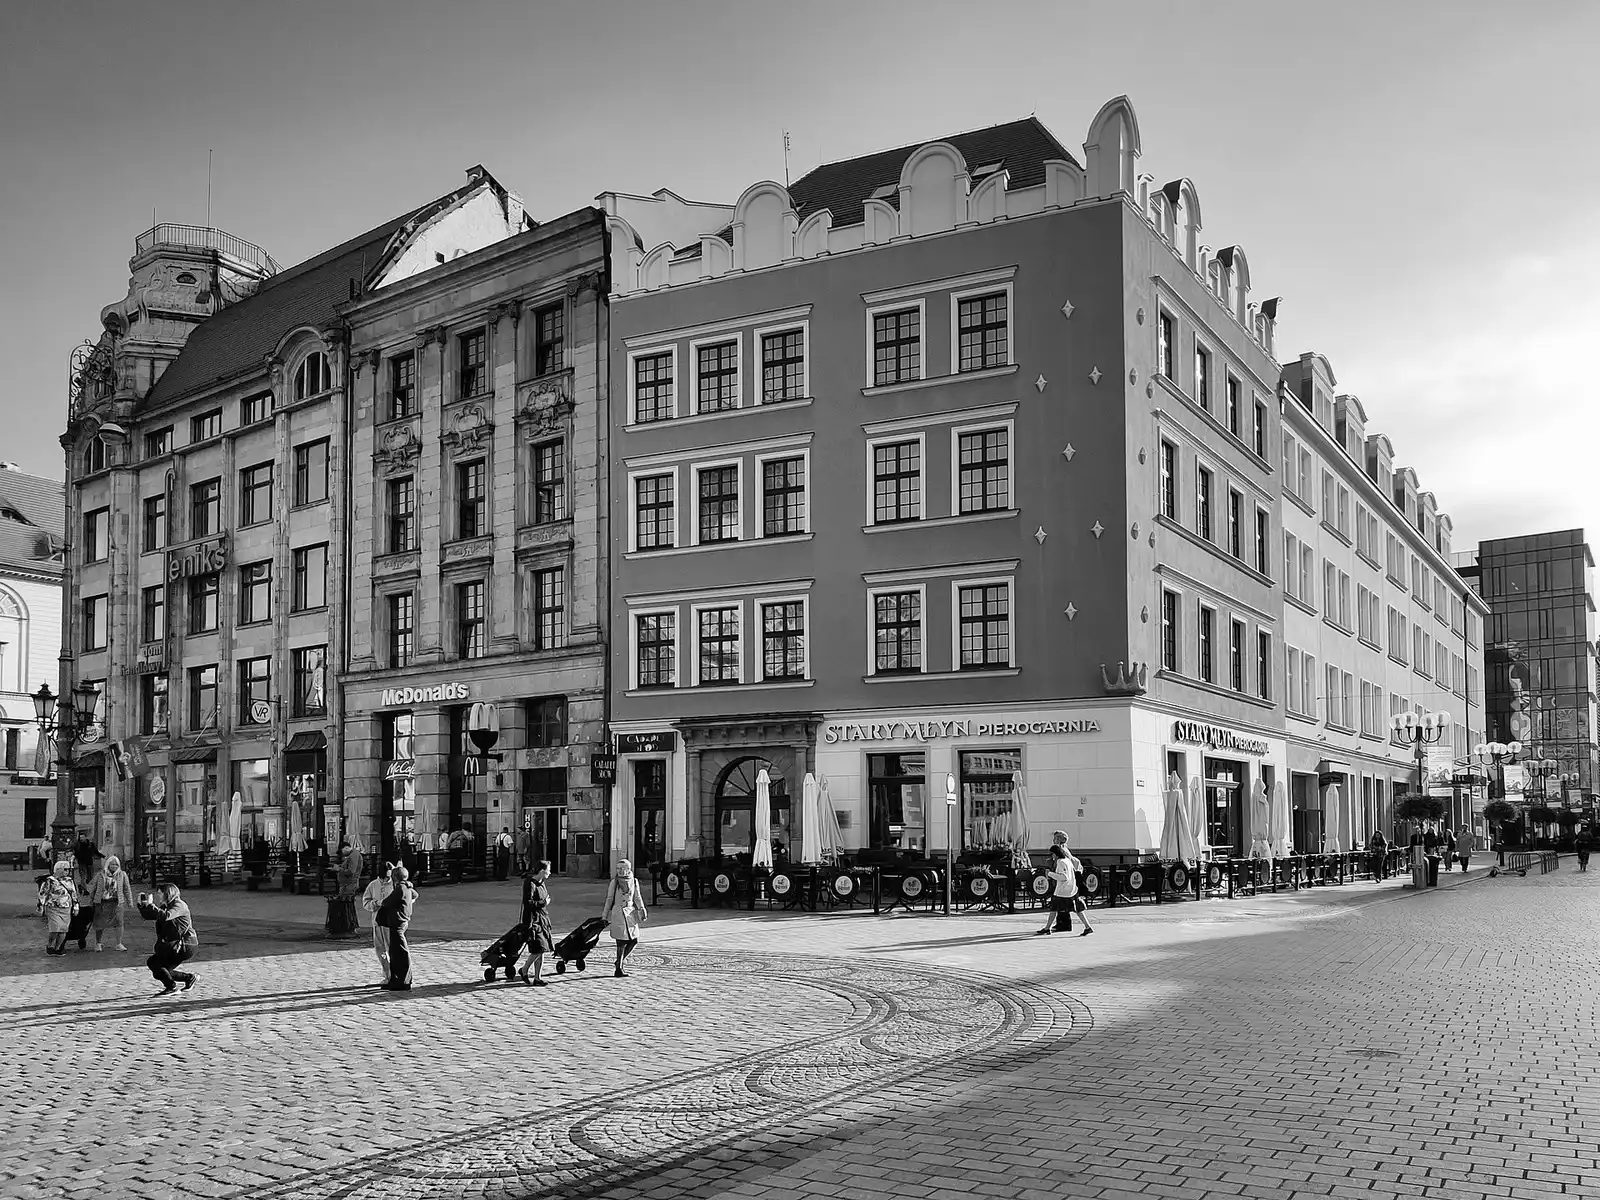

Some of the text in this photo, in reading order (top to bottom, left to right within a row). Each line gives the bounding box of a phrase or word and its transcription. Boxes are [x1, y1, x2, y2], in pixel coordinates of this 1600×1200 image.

[381, 682, 469, 706] McDonald's
[824, 723, 899, 744] STARY
[977, 719, 1101, 736] PIEROGARNIA
[1175, 721, 1209, 742] STARY
